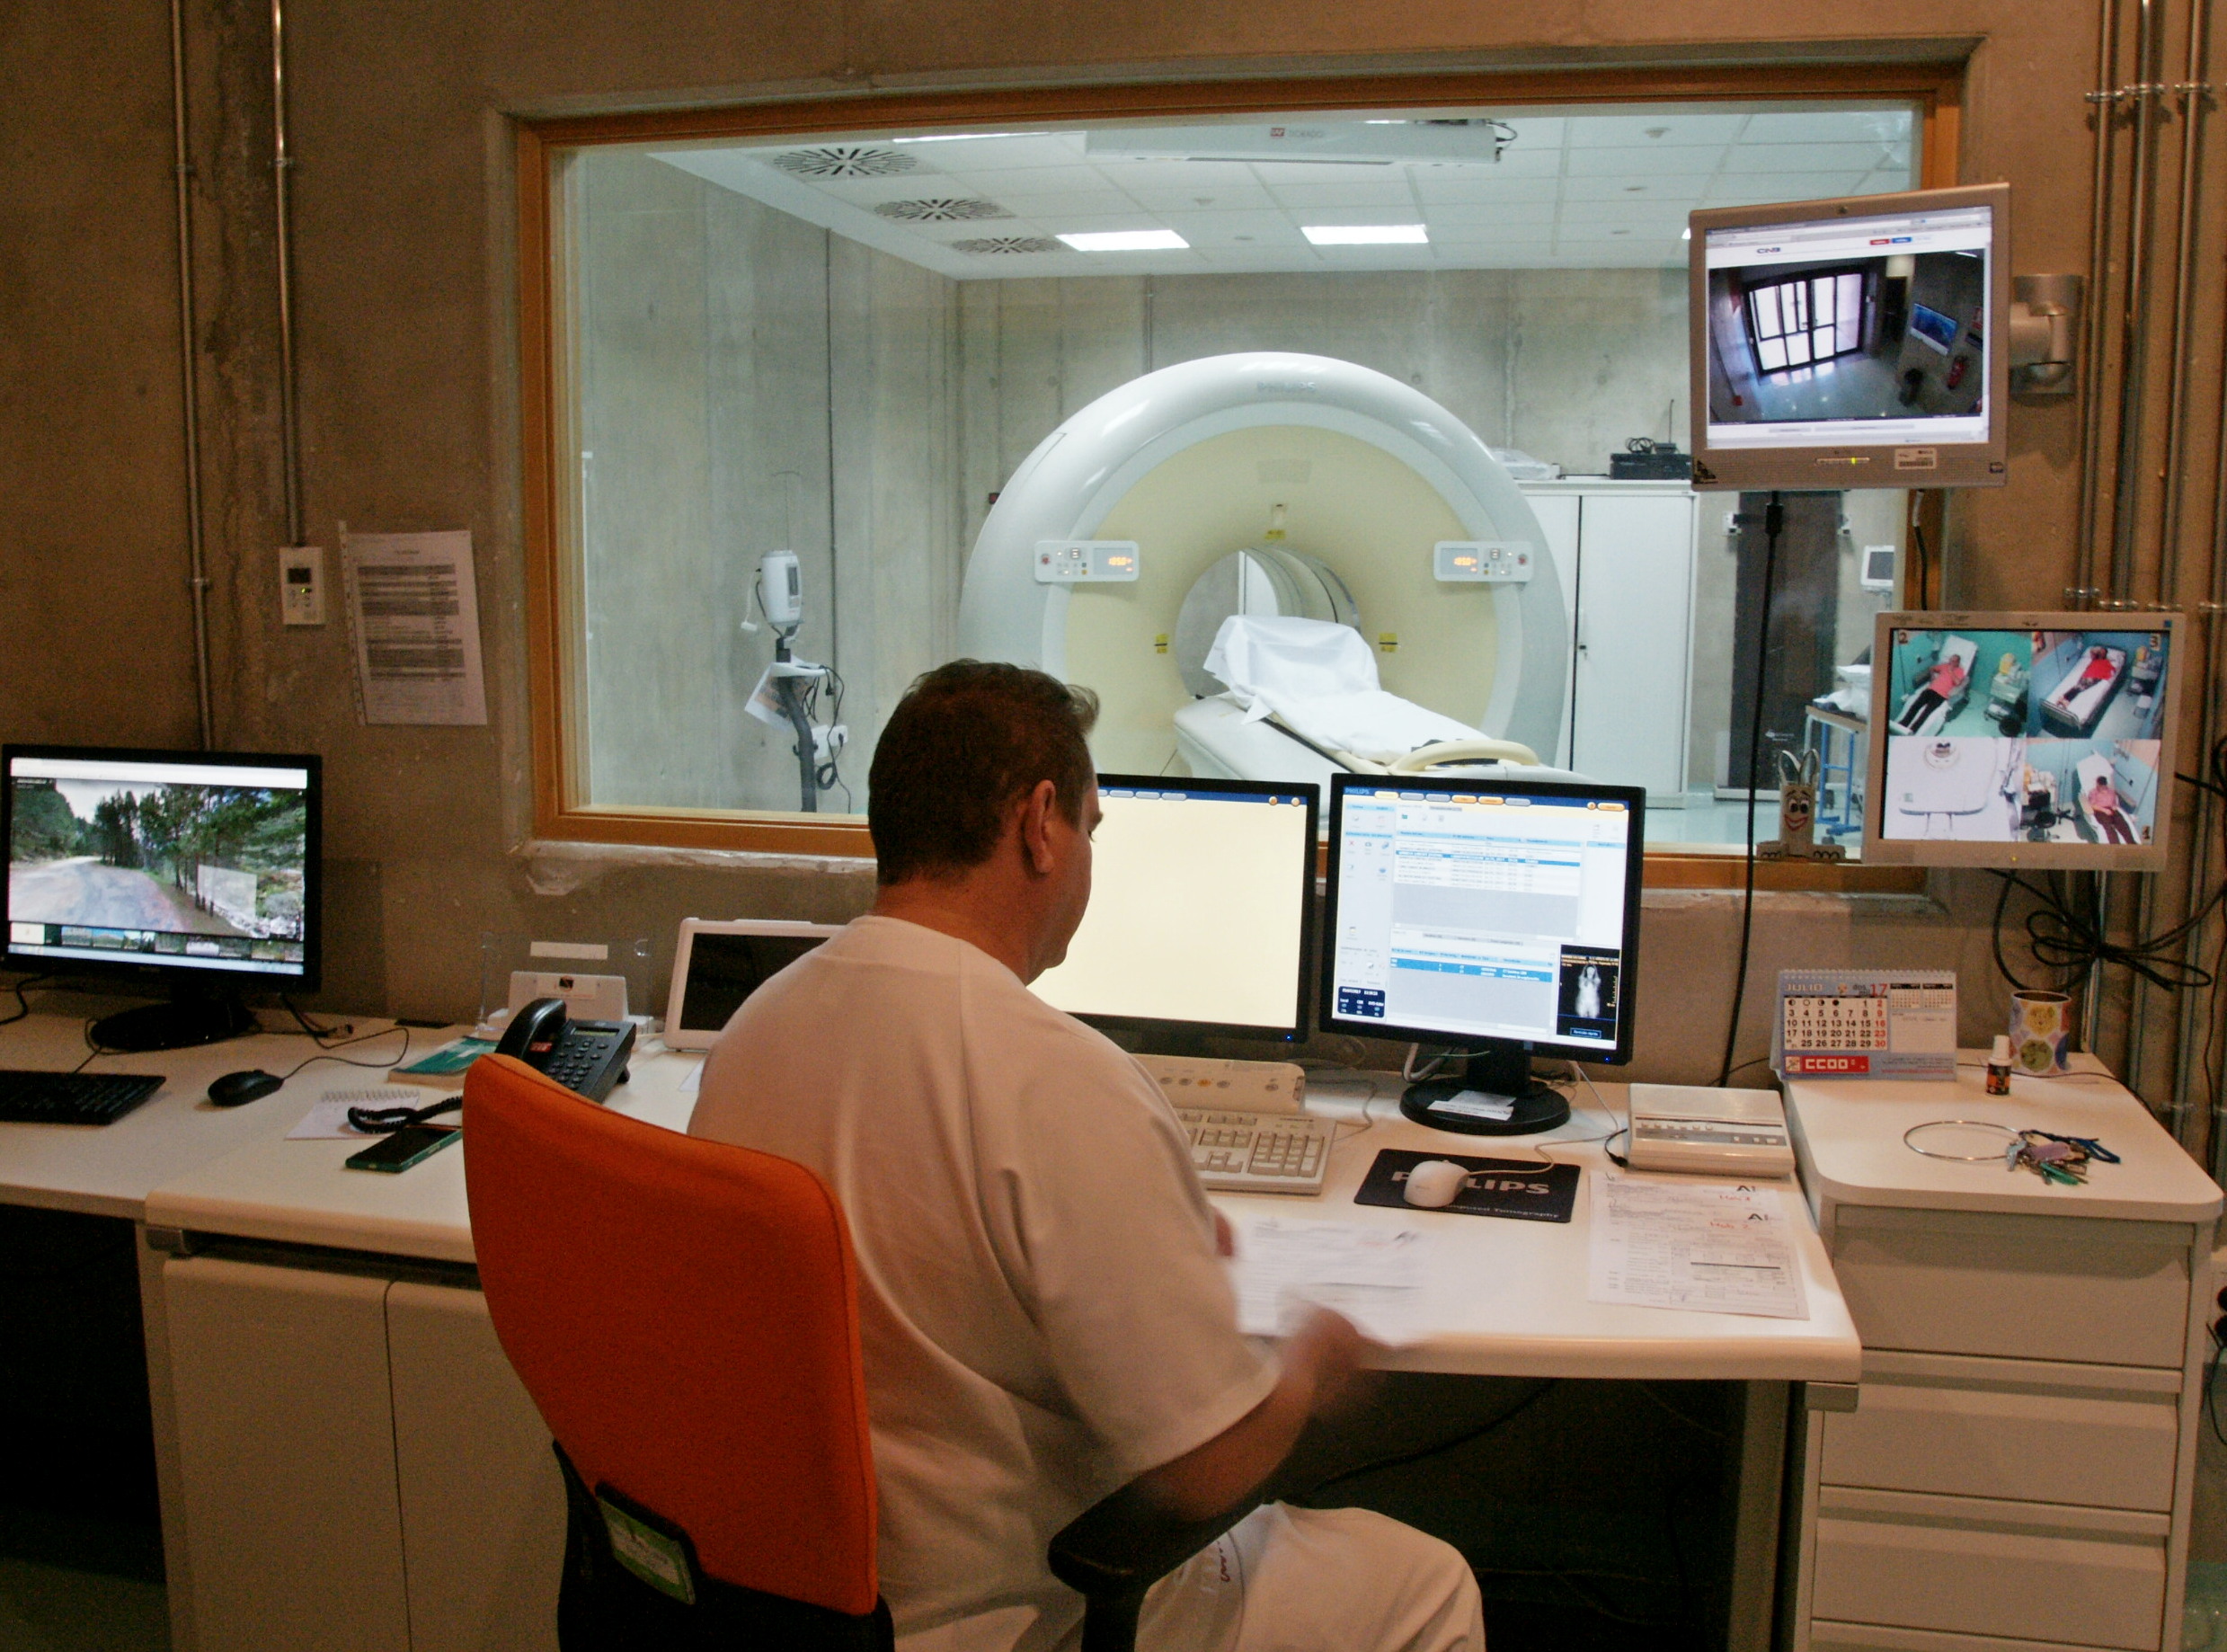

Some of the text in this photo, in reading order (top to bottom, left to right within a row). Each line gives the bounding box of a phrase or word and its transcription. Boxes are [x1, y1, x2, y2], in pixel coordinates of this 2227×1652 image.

[1788, 983, 1822, 991] JULIO
[1870, 983, 1887, 996] 17
[1806, 1059, 1848, 1070] CCOO
[1391, 1171, 1549, 1195] PLIPS
